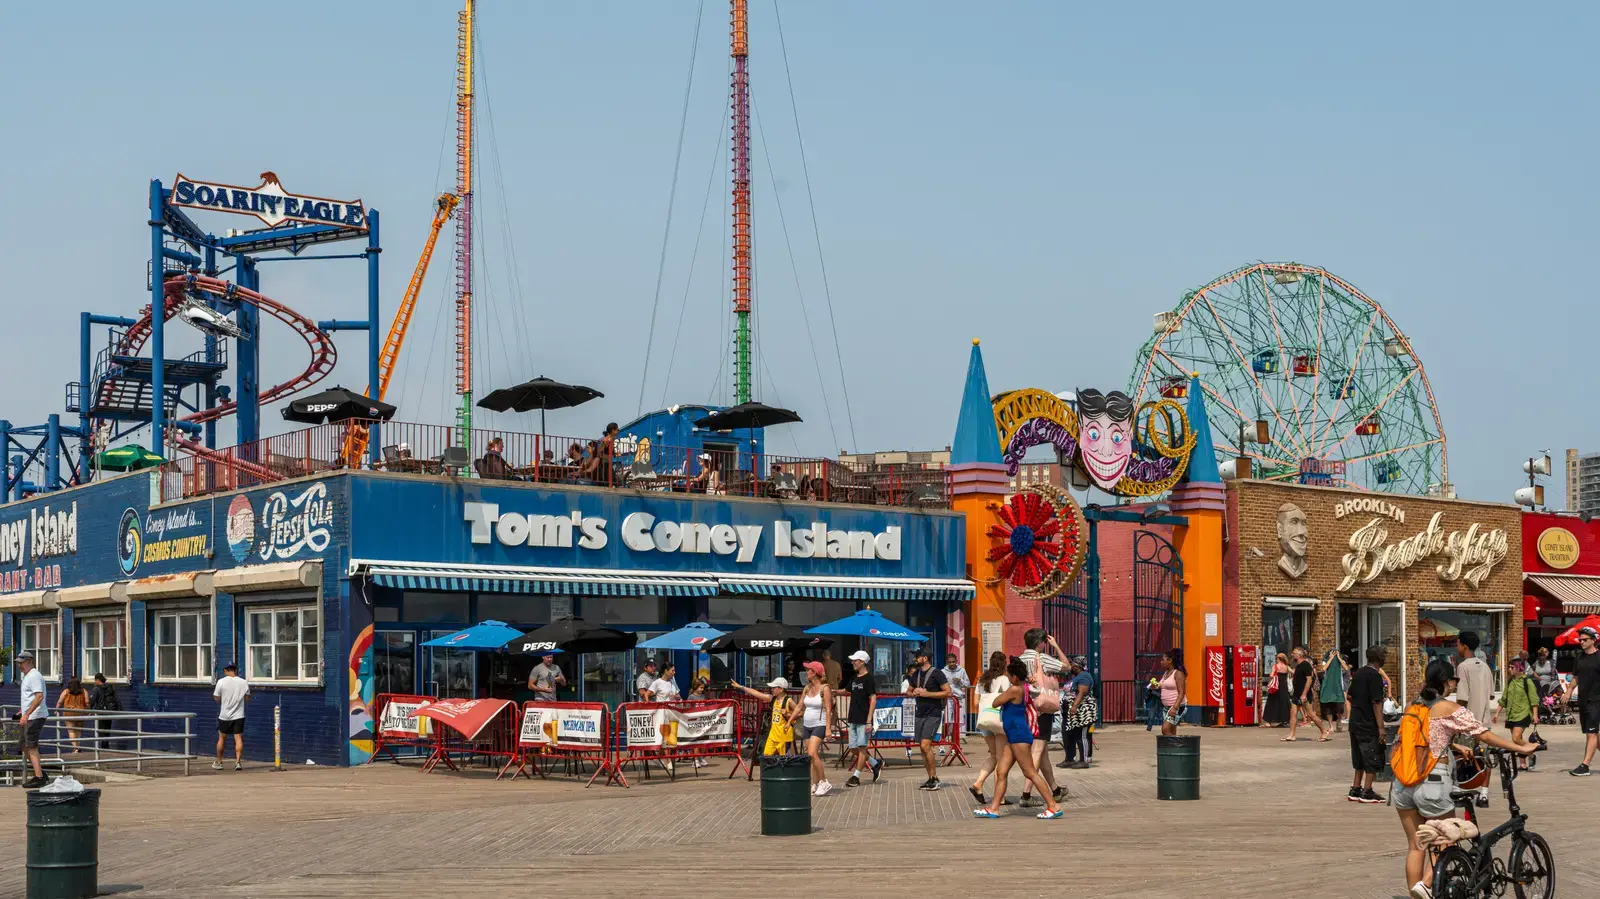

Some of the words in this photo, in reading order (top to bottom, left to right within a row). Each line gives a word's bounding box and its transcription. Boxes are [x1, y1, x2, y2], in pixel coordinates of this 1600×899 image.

[176, 181, 282, 215] SOARIN'
[284, 198, 364, 226] EAGLE
[1302, 460, 1345, 475] WONDER
[1335, 499, 1405, 523] BROOKLYN
[0, 518, 27, 567] ney
[31, 500, 77, 558] Island
[146, 514, 166, 541] Coney
[166, 507, 190, 531] Island
[463, 501, 608, 549] Tom's
[621, 511, 763, 563] Coney
[774, 519, 902, 561] Island
[143, 540, 172, 563] COSMOS
[171, 534, 207, 560] COUNTRY!
[1336, 511, 1446, 592] Beach
[1436, 522, 1508, 589] Shop
[1545, 543, 1558, 551] CONEY
[1560, 544, 1574, 552] ISLAND
[35, 564, 62, 589] BAR
[522, 641, 557, 651] PEPSI
[523, 724, 540, 735] ISLAND
[629, 716, 652, 727] CONEY
[629, 727, 655, 738] ISLAND
